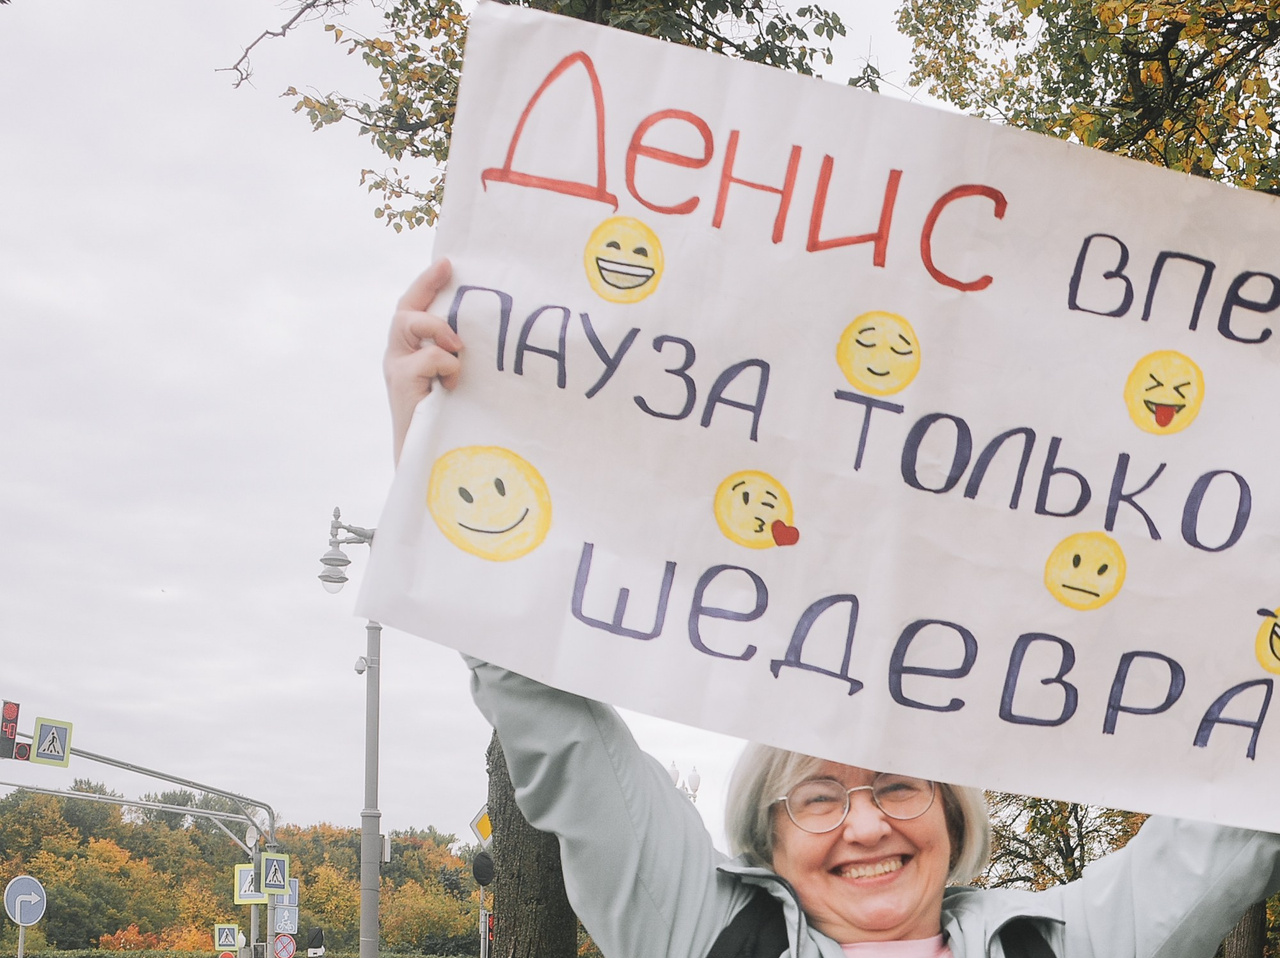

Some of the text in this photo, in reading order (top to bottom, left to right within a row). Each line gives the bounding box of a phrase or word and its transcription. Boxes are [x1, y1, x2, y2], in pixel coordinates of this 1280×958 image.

[481, 50, 1008, 292] Денис
[447, 285, 771, 443] ПАУЗА
[2, 722, 17, 739] 40
